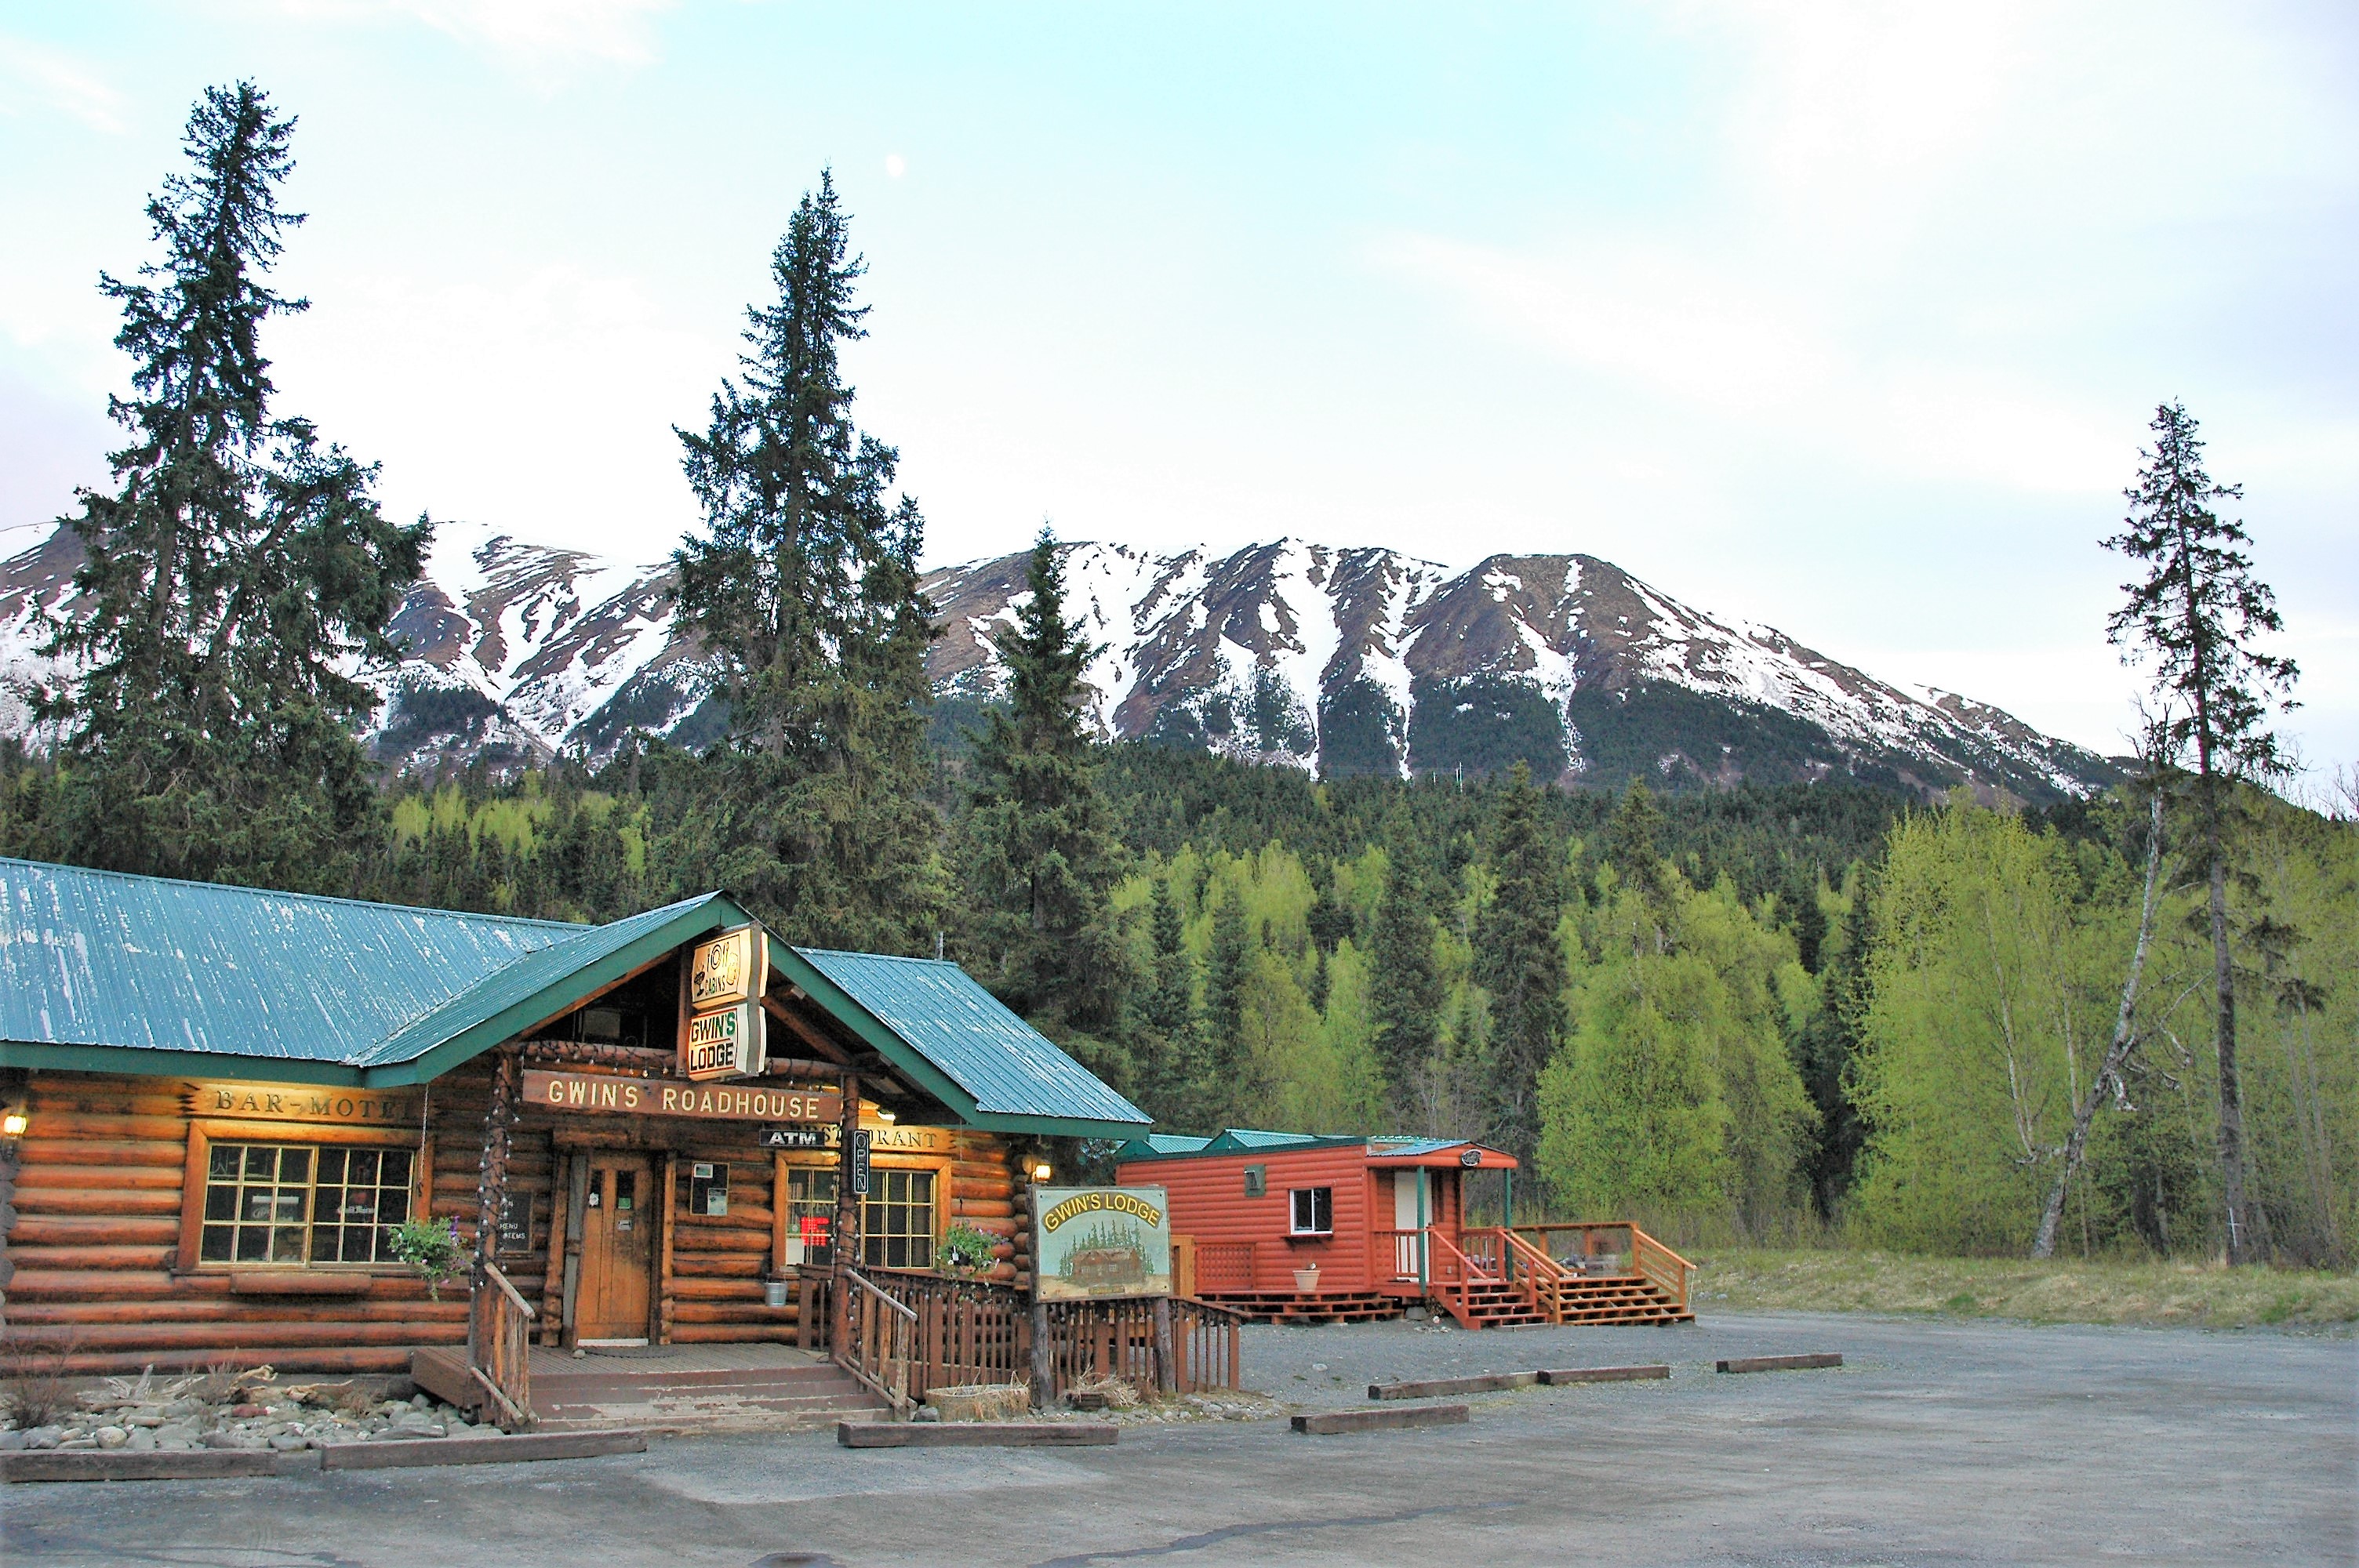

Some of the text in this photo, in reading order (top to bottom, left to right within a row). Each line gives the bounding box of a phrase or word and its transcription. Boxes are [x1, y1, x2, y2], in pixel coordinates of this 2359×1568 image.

[705, 975, 725, 996] CABINS
[692, 1012, 736, 1042] GWIN'S
[690, 1043, 733, 1071] LODGE
[548, 1080, 820, 1119] GWIN'S ROADHOUSE
[768, 1131, 816, 1145] ATM
[856, 1134, 867, 1190] OPEN
[800, 1202, 831, 1214] OEN
[1045, 1193, 1160, 1230] GWIN'S LODGE
